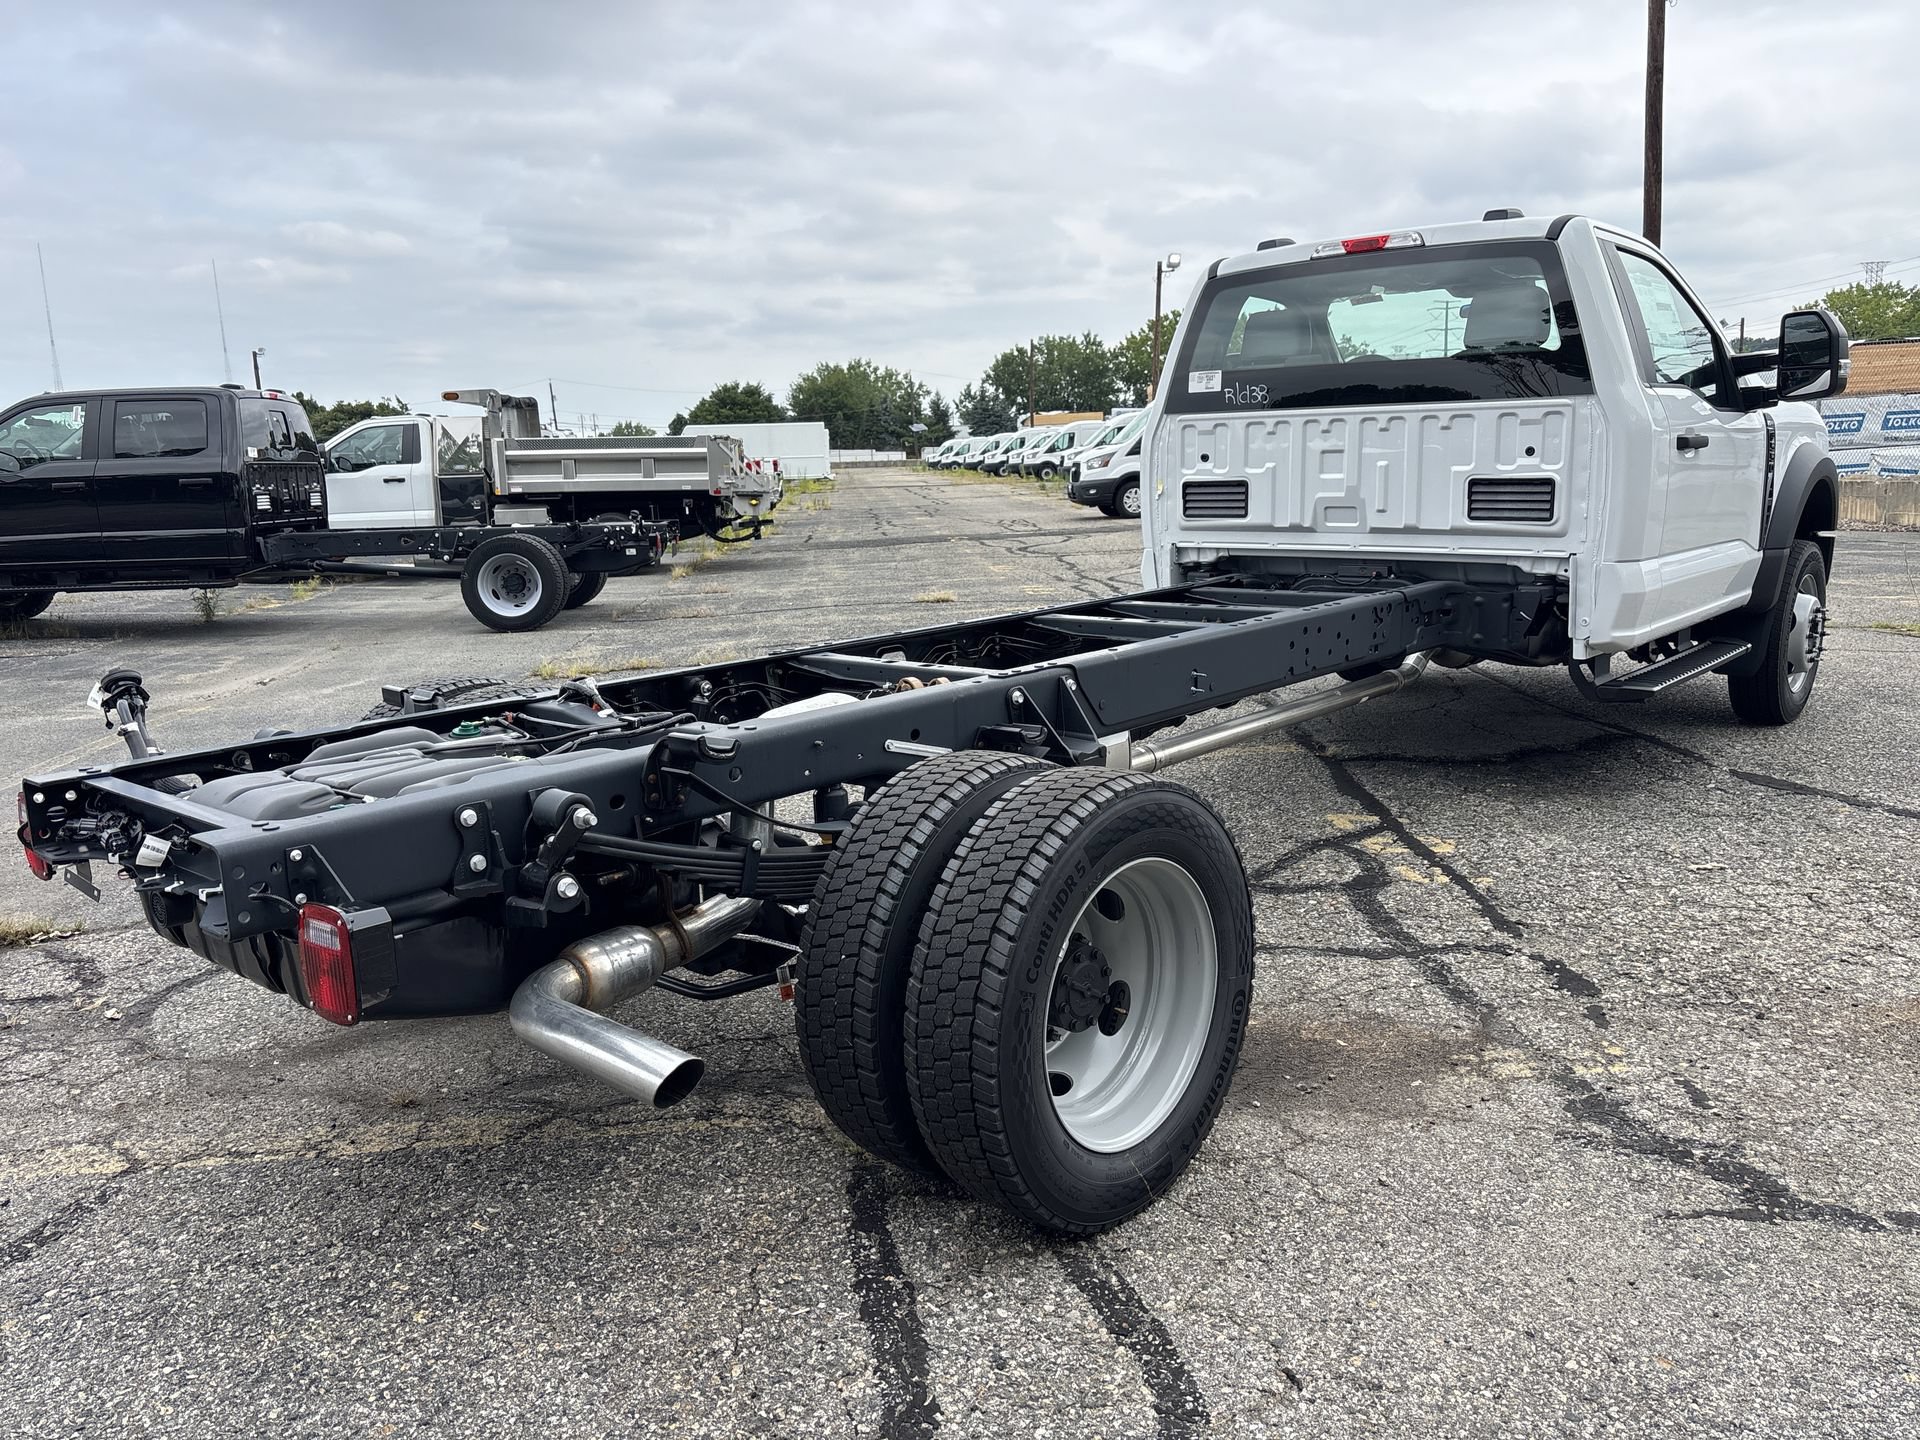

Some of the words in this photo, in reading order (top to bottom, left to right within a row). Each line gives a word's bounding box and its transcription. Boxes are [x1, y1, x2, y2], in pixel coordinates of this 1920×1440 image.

[1826, 420, 1858, 430] OLKO
[1026, 921, 1053, 984] Conti
[1048, 874, 1077, 922] HDR
[1075, 860, 1086, 879] 5
[1192, 988, 1246, 1138] Continental
